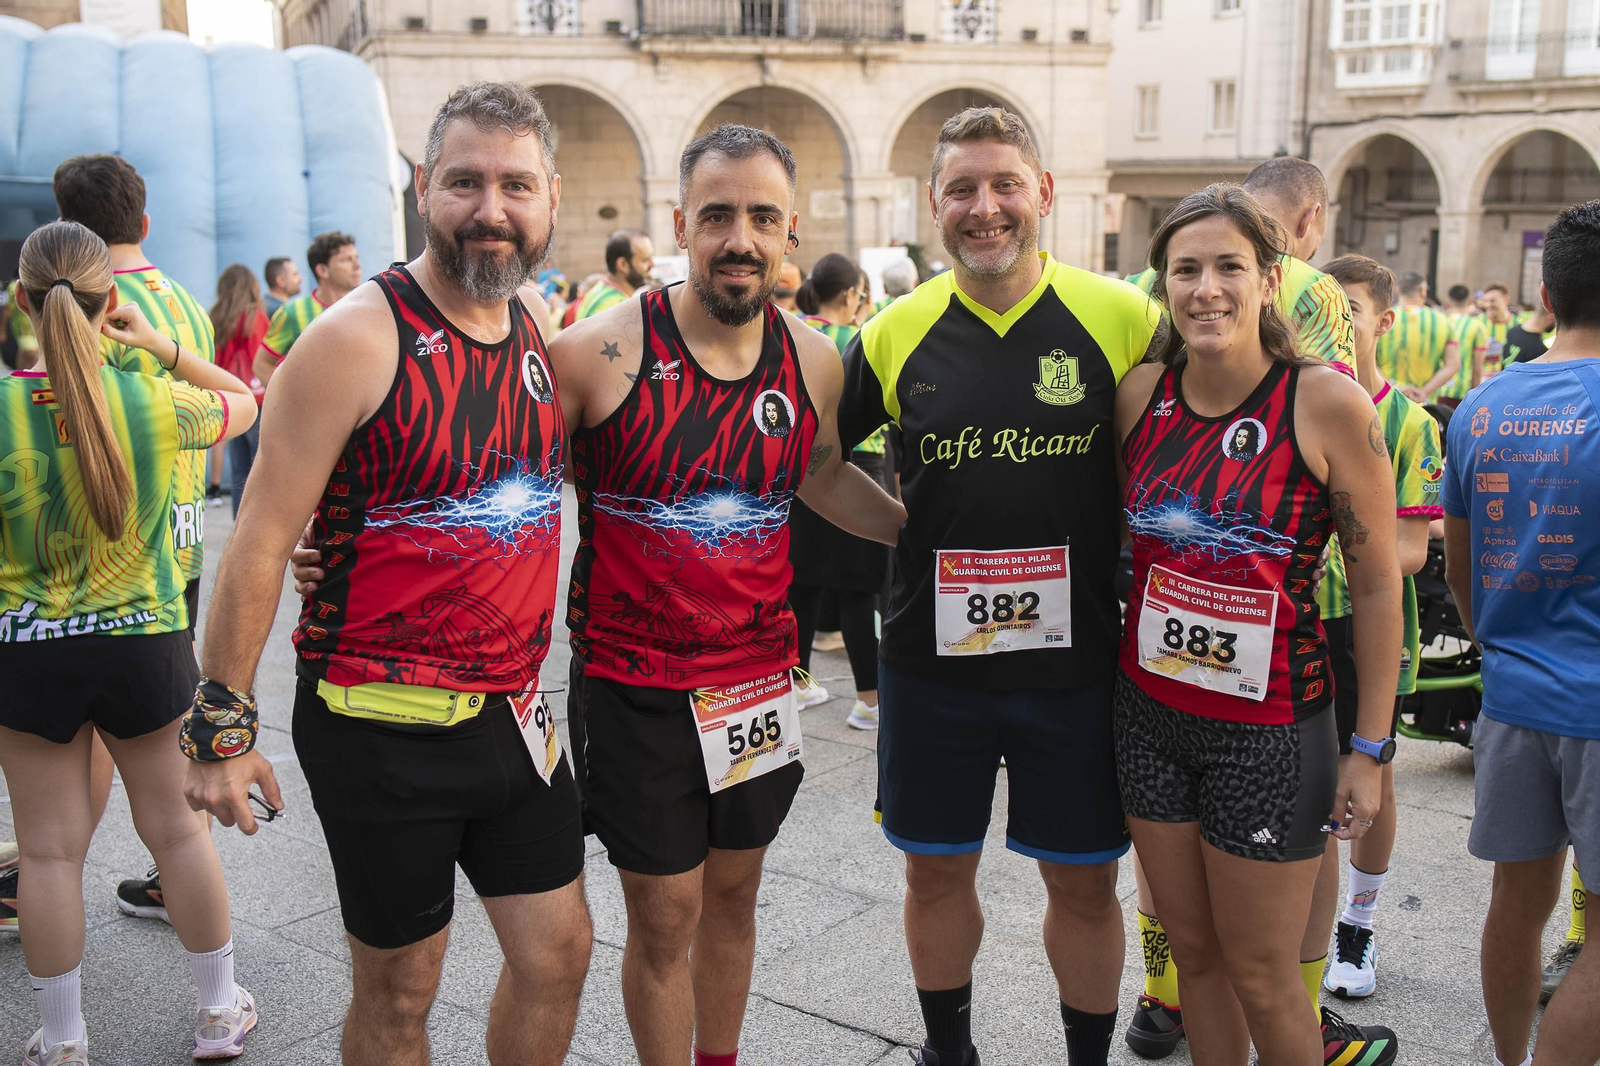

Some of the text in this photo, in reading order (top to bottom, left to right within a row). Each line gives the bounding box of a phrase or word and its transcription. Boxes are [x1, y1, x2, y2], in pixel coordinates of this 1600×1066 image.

[417, 343, 449, 357] ZICO
[650, 372, 680, 381] ZICO
[1153, 409, 1173, 417] ZICO
[1503, 403, 1577, 416] Concello de
[1499, 419, 1588, 437] OURENSE
[919, 423, 1101, 470] Café Ricard
[1500, 447, 1560, 463] CaixaBank
[1483, 537, 1517, 547] Apersa
[1537, 534, 1575, 544] GADIS
[962, 554, 1052, 566] III CARRERA DEL PILAR
[953, 563, 1062, 577] GUARDIA CIVIL DE OURENSE
[1168, 577, 1257, 605] III CARRERA DEL PILAR
[966, 591, 1040, 625] 882
[1159, 586, 1267, 617] GUARDIA CIVIL DE OURENSE
[976, 622, 1031, 634] CARLOS QUINTAIROS
[1163, 617, 1238, 664] 883
[1156, 646, 1179, 660] TAMARA
[1178, 653, 1198, 666] RAMOS
[1198, 660, 1242, 675] BARRIONUEVO
[725, 679, 755, 695] CARRERA
[755, 677, 767, 686] DEL
[707, 678, 789, 712] GUARDIA CIVIL DE OURENSE
[727, 709, 781, 756] 565
